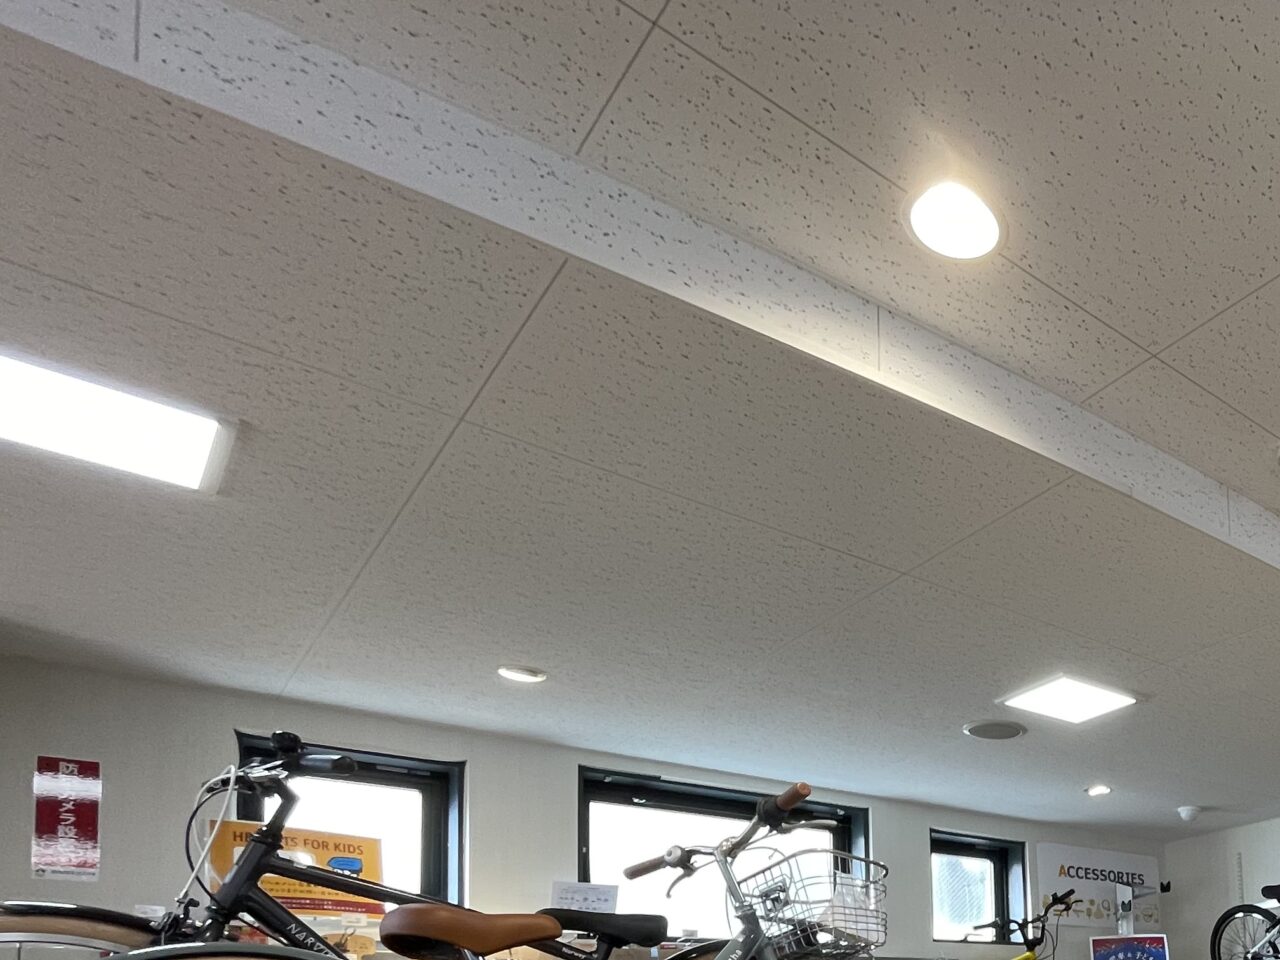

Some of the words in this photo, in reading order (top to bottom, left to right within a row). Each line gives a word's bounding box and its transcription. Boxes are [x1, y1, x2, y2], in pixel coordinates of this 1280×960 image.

[233, 831, 298, 847] HETS
[304, 838, 329, 850] FOR
[333, 842, 364, 855] KIDS
[1058, 864, 1145, 886] ACCESSORIES
[561, 947, 587, 960] Norway
